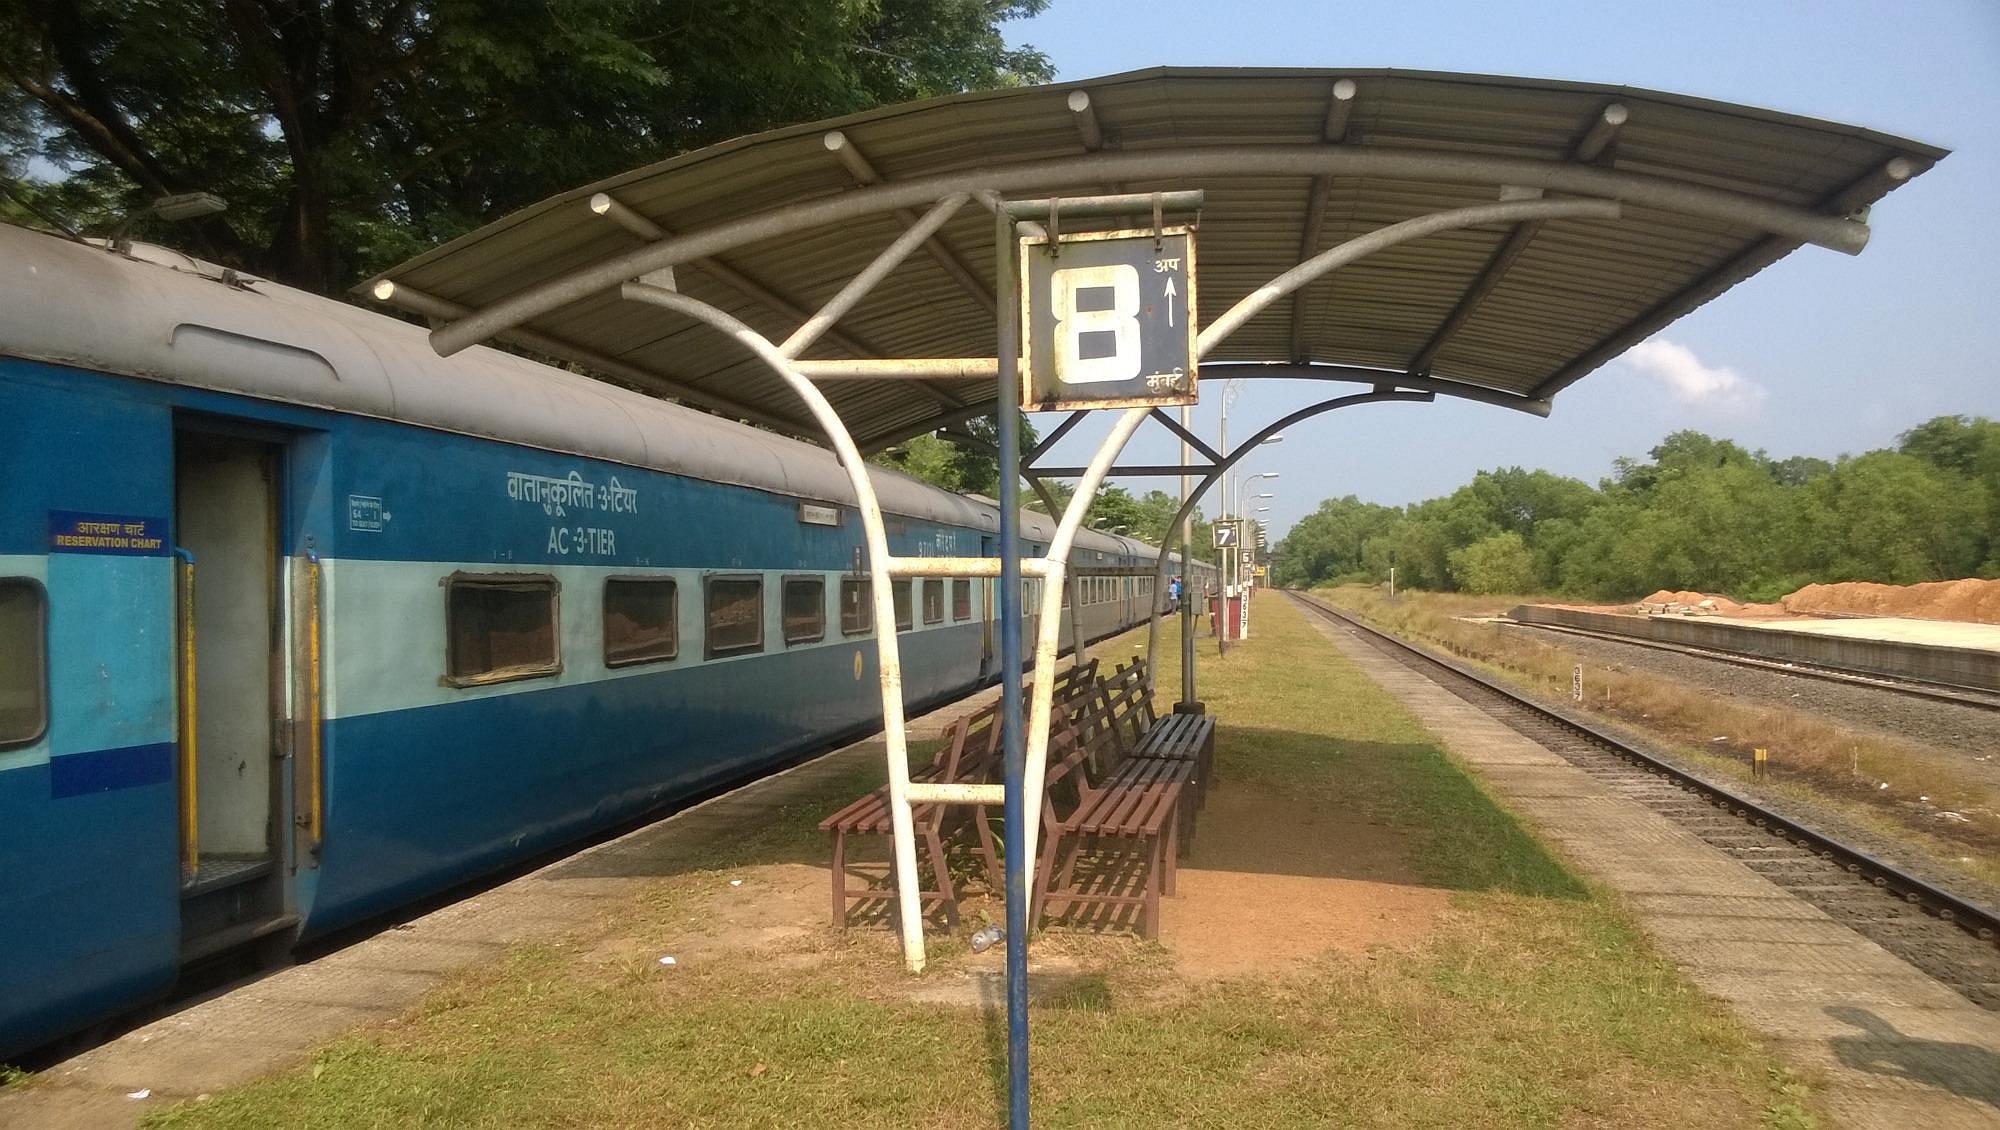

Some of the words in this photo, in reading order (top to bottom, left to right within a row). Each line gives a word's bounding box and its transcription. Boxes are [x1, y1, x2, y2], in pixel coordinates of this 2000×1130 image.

[1154, 257, 1181, 273] अप
[1050, 263, 1142, 384] 8
[507, 470, 595, 517] वातानुकूलित
[78, 521, 120, 535] आरक्षण
[124, 521, 145, 536] चार्ट
[1217, 528, 1231, 545] 7
[56, 534, 129, 549] RESERVATION
[130, 538, 162, 550] CHART
[547, 526, 570, 555] AC
